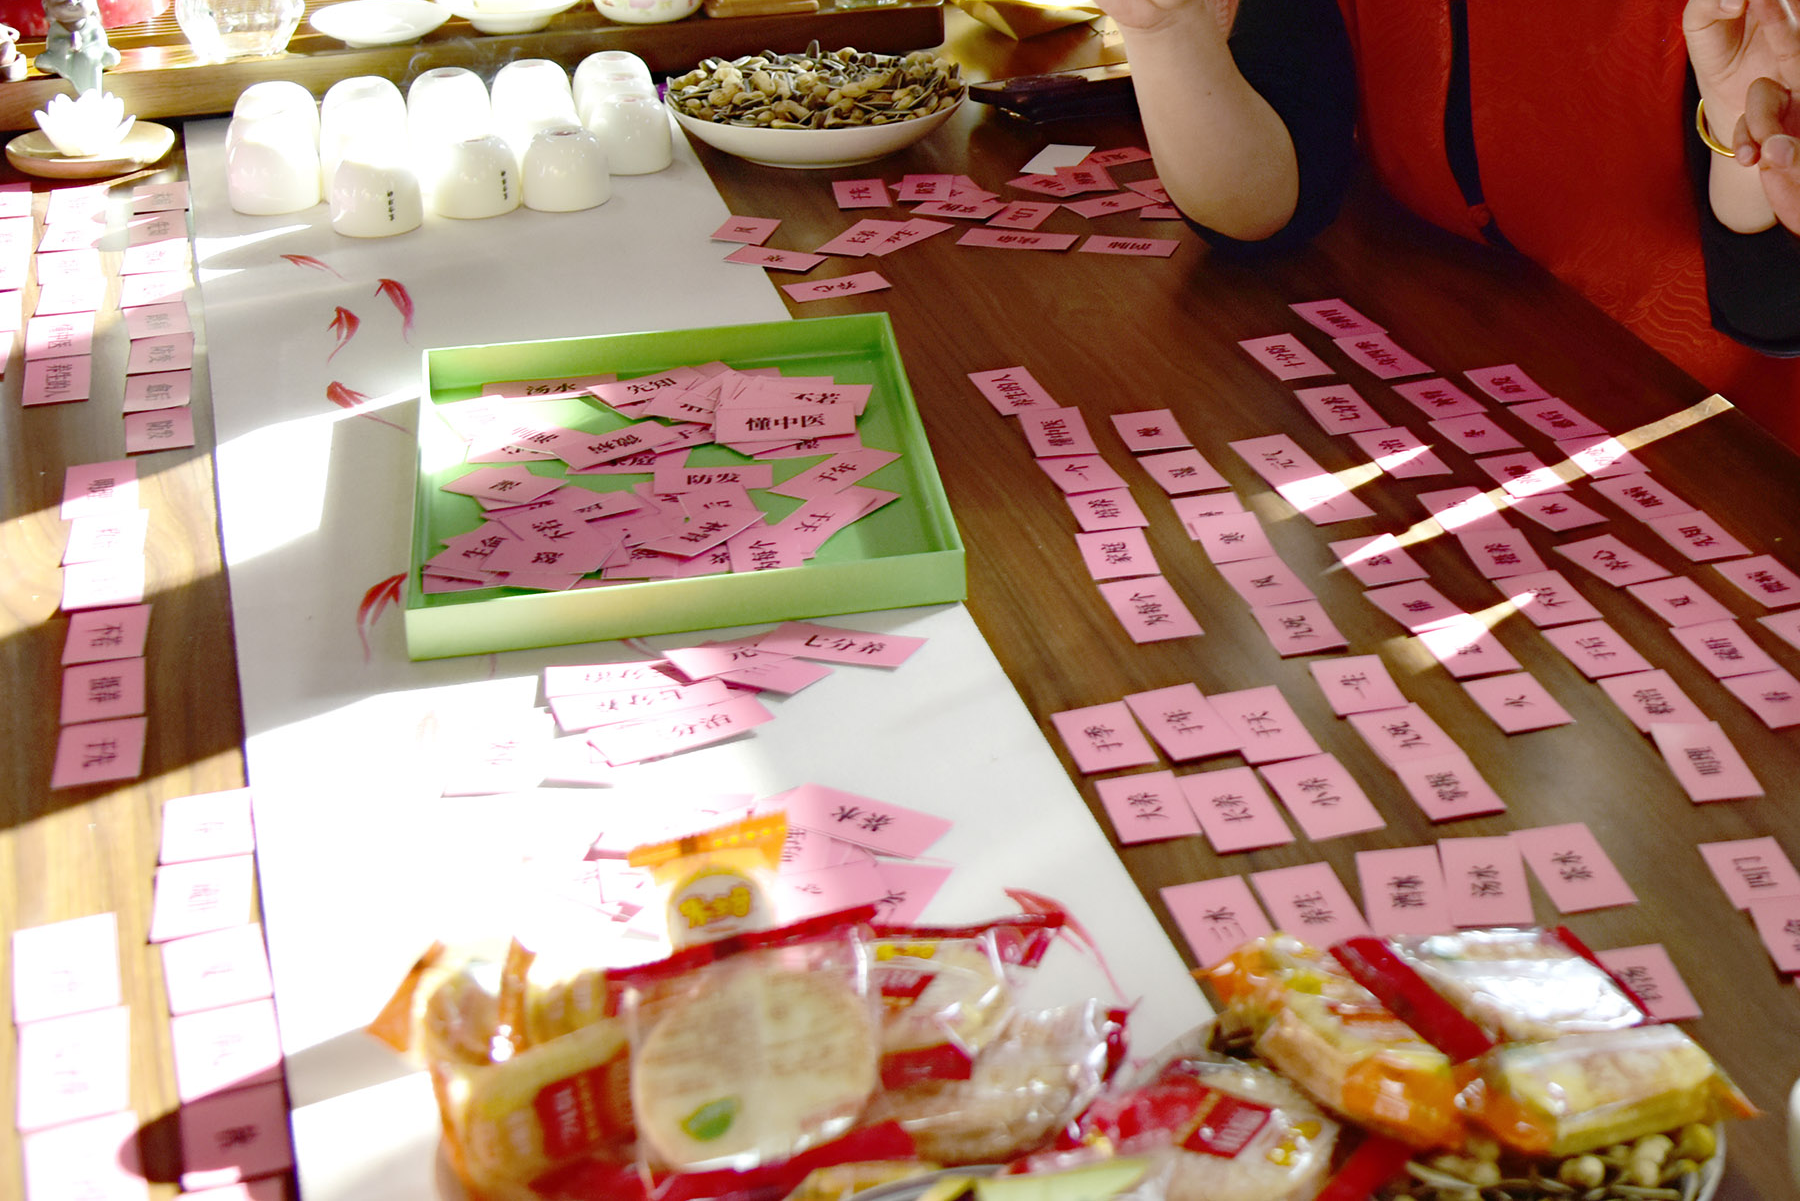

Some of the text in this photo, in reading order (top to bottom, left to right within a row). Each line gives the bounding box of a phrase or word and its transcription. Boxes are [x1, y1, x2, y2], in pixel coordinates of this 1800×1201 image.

[846, 230, 879, 243] 长养
[811, 280, 856, 293] 养心
[148, 343, 175, 363] 防变
[1264, 343, 1306, 367] 十分防
[43, 363, 72, 397] 养生的人
[526, 382, 577, 396] 汤水
[626, 377, 677, 395] 先知
[990, 373, 1036, 407] 养生的人
[791, 392, 841, 405] 不若
[1320, 395, 1361, 421] 七分养
[145, 419, 173, 441] 防发
[745, 413, 826, 432] 懂中医
[1039, 418, 1074, 446] 懂中医
[1261, 448, 1296, 468] 元气
[686, 472, 741, 485] 防发
[813, 462, 858, 483] 于年
[1063, 463, 1090, 481] 一个
[1087, 498, 1120, 518] 培养
[532, 518, 576, 543] 不若
[793, 511, 836, 533] 于天
[1217, 530, 1246, 545] 寒
[1677, 525, 1717, 547] 先知
[1100, 541, 1132, 564] 家庭
[1592, 549, 1632, 571] 养心
[1249, 574, 1280, 589] 风
[1526, 586, 1567, 607] 不若
[1128, 592, 1171, 627] 为每个
[82, 621, 125, 649] 不若
[1278, 614, 1314, 639] 九死
[803, 633, 889, 656] 七分养
[1574, 636, 1616, 658] 于后
[1339, 671, 1369, 698] 一生
[1502, 693, 1530, 708] 火
[1162, 708, 1204, 734] 于年
[1241, 710, 1282, 736] 于天
[1083, 724, 1123, 750] 于季
[1386, 720, 1427, 749] 九死
[79, 738, 118, 769] 于先
[1684, 747, 1721, 776] 明理
[1296, 776, 1341, 806] 小养
[1425, 772, 1468, 802] 掌握
[1126, 791, 1164, 820] 大养
[1211, 793, 1254, 822] 长养
[831, 805, 896, 832] 茶水
[1551, 850, 1593, 882] 茶水
[1732, 855, 1778, 888] 四门
[1387, 875, 1425, 908] 酒水
[1467, 864, 1503, 897] 汤水
[1292, 890, 1334, 924] 养生
[1202, 905, 1248, 941] 三水
